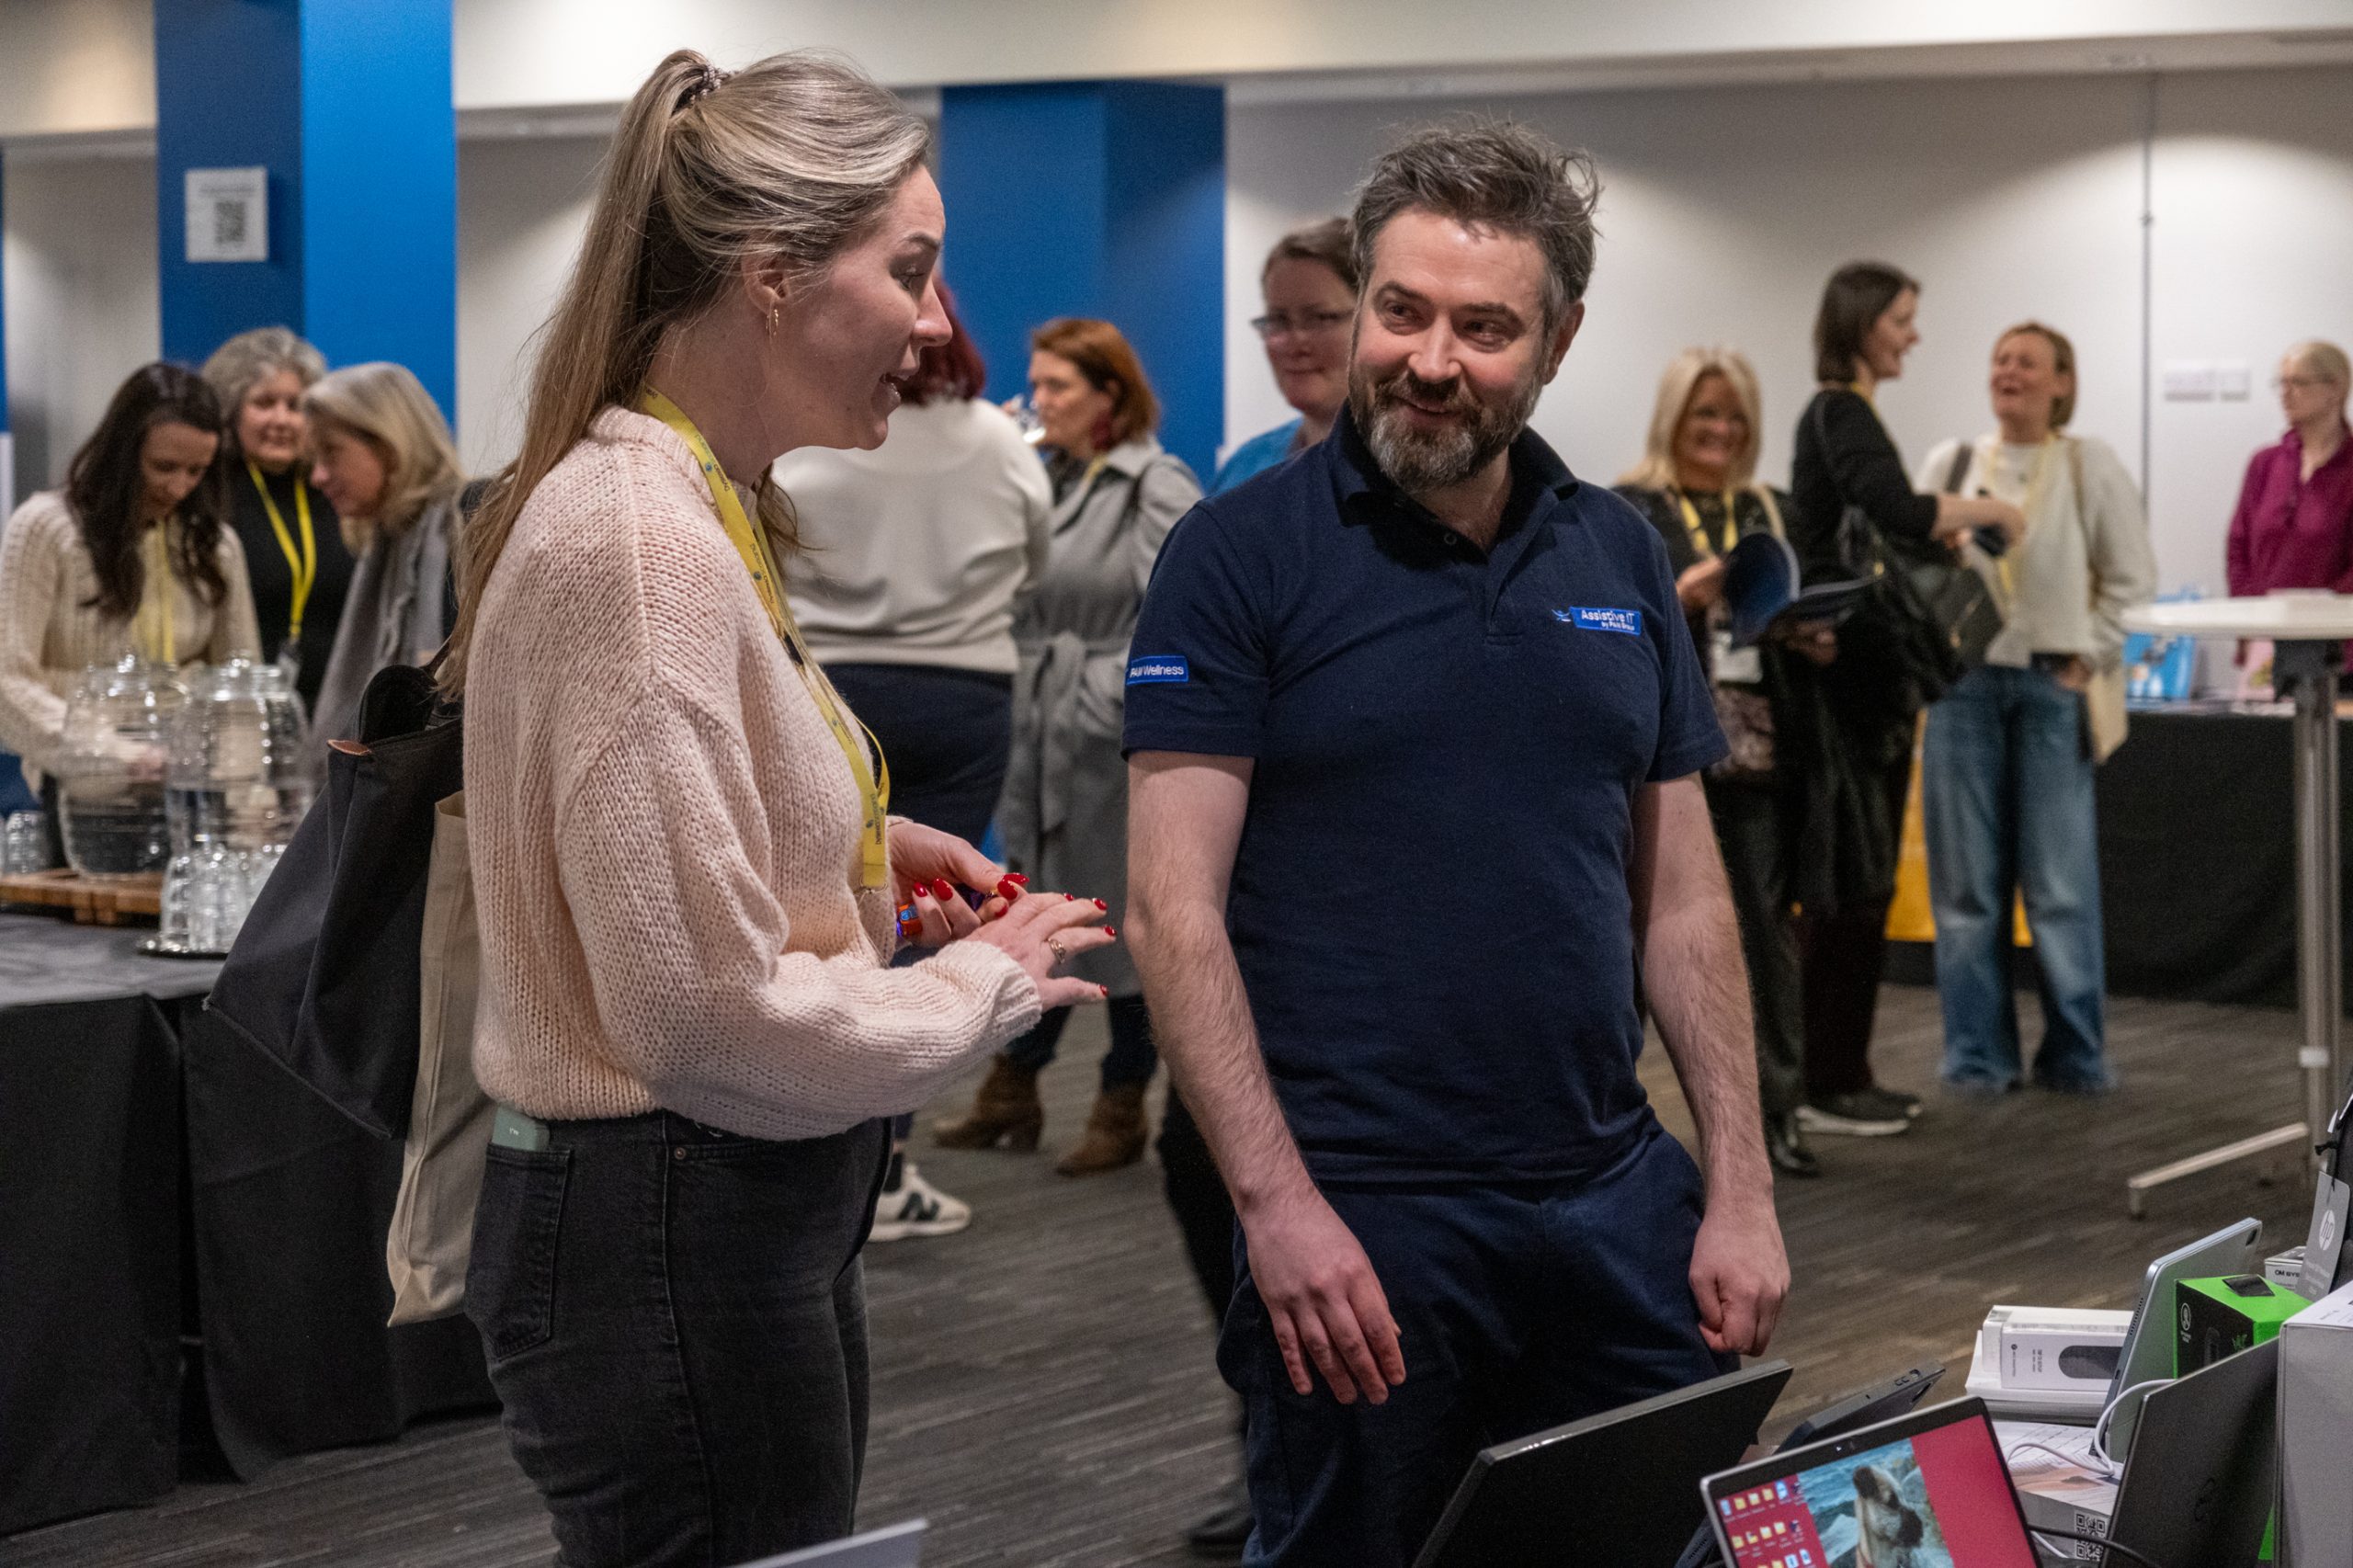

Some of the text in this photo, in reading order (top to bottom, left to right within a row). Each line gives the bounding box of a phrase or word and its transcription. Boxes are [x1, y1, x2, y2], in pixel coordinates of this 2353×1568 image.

[1581, 610, 1635, 624] Assistive IT
[1142, 665, 1184, 675] Wellness
